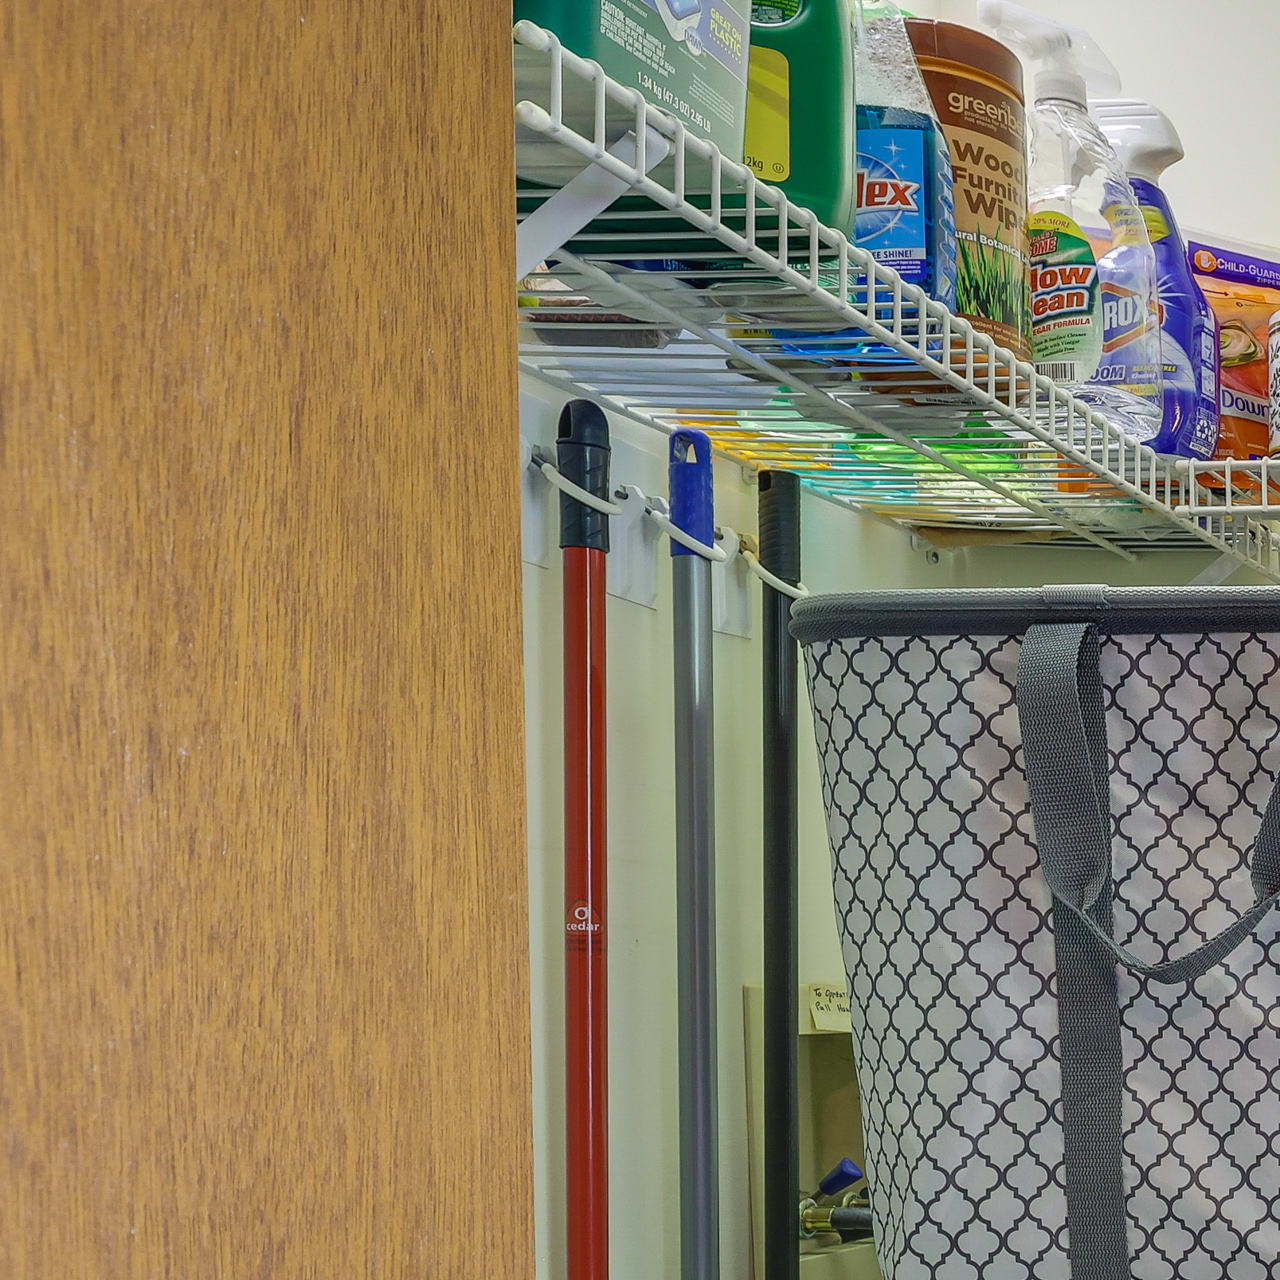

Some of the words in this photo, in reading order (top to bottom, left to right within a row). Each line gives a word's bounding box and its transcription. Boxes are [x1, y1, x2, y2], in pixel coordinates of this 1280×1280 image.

[711, 7, 731, 32] GREAT
[732, 27, 742, 44] ON
[711, 20, 742, 57] PLASTIC
[653, 81, 662, 100] kg
[704, 117, 711, 133] LB
[952, 139, 1023, 187] Wood
[1033, 217, 1047, 225] 20%
[1049, 217, 1071, 229] MORE
[884, 249, 912, 259] SHINE!
[1256, 276, 1280, 287] ZIPPER
[1053, 318, 1091, 330] FORMULA
[1222, 389, 1269, 418] Down
[566, 920, 600, 932] cedar
[813, 987, 822, 998] To
[815, 1000, 832, 1012] Pull
